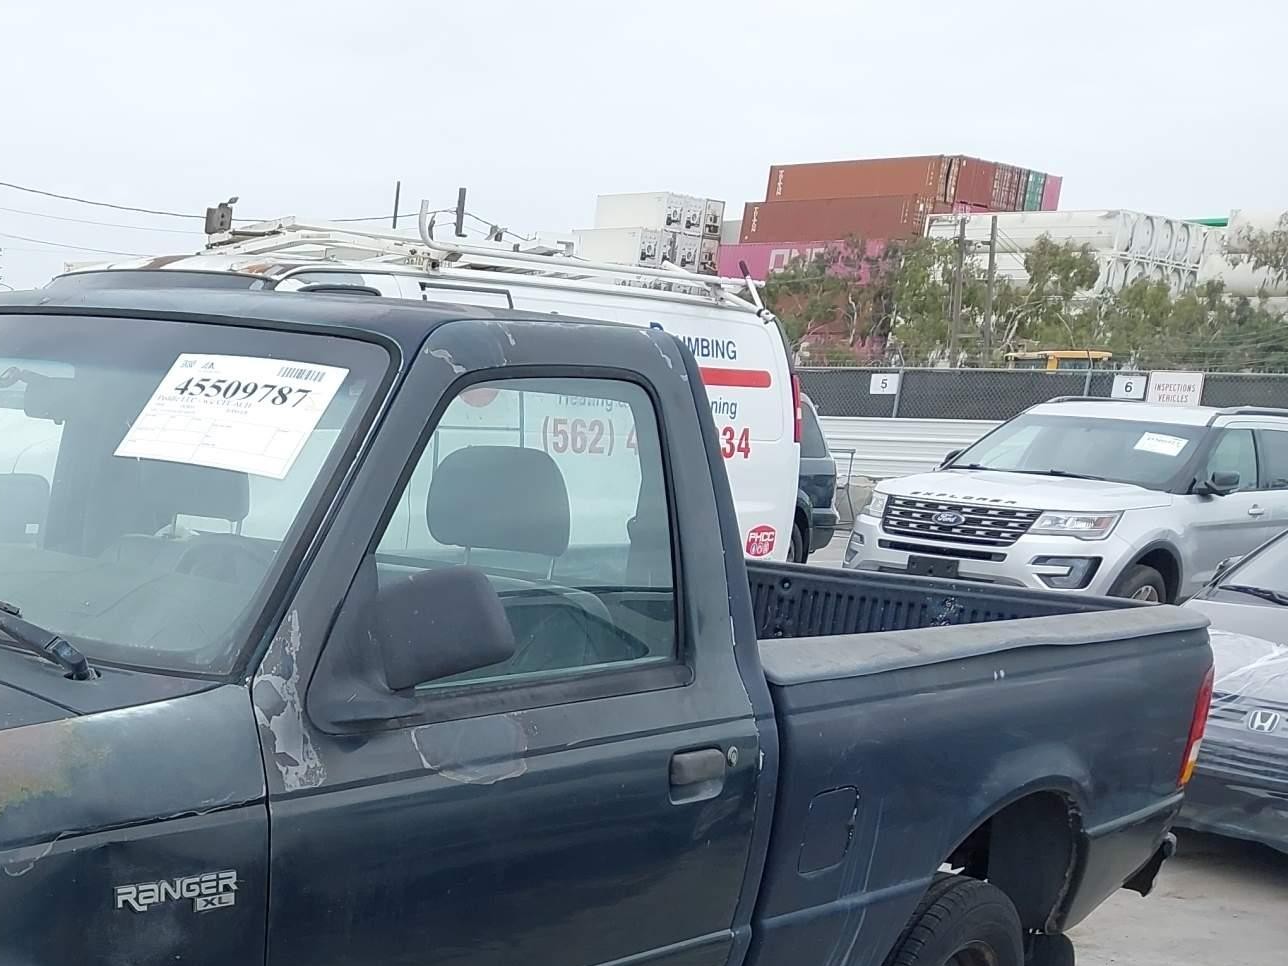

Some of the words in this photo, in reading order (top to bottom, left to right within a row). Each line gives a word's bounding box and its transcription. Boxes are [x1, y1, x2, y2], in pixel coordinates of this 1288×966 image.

[880, 377, 889, 390] 5
[1124, 381, 1134, 393] 6
[1154, 383, 1196, 393] INSPECTIONS
[174, 376, 313, 409] 45509787
[542, 415, 615, 457] (562)
[910, 490, 1017, 505] EXPLORER
[199, 894, 233, 910] XL
